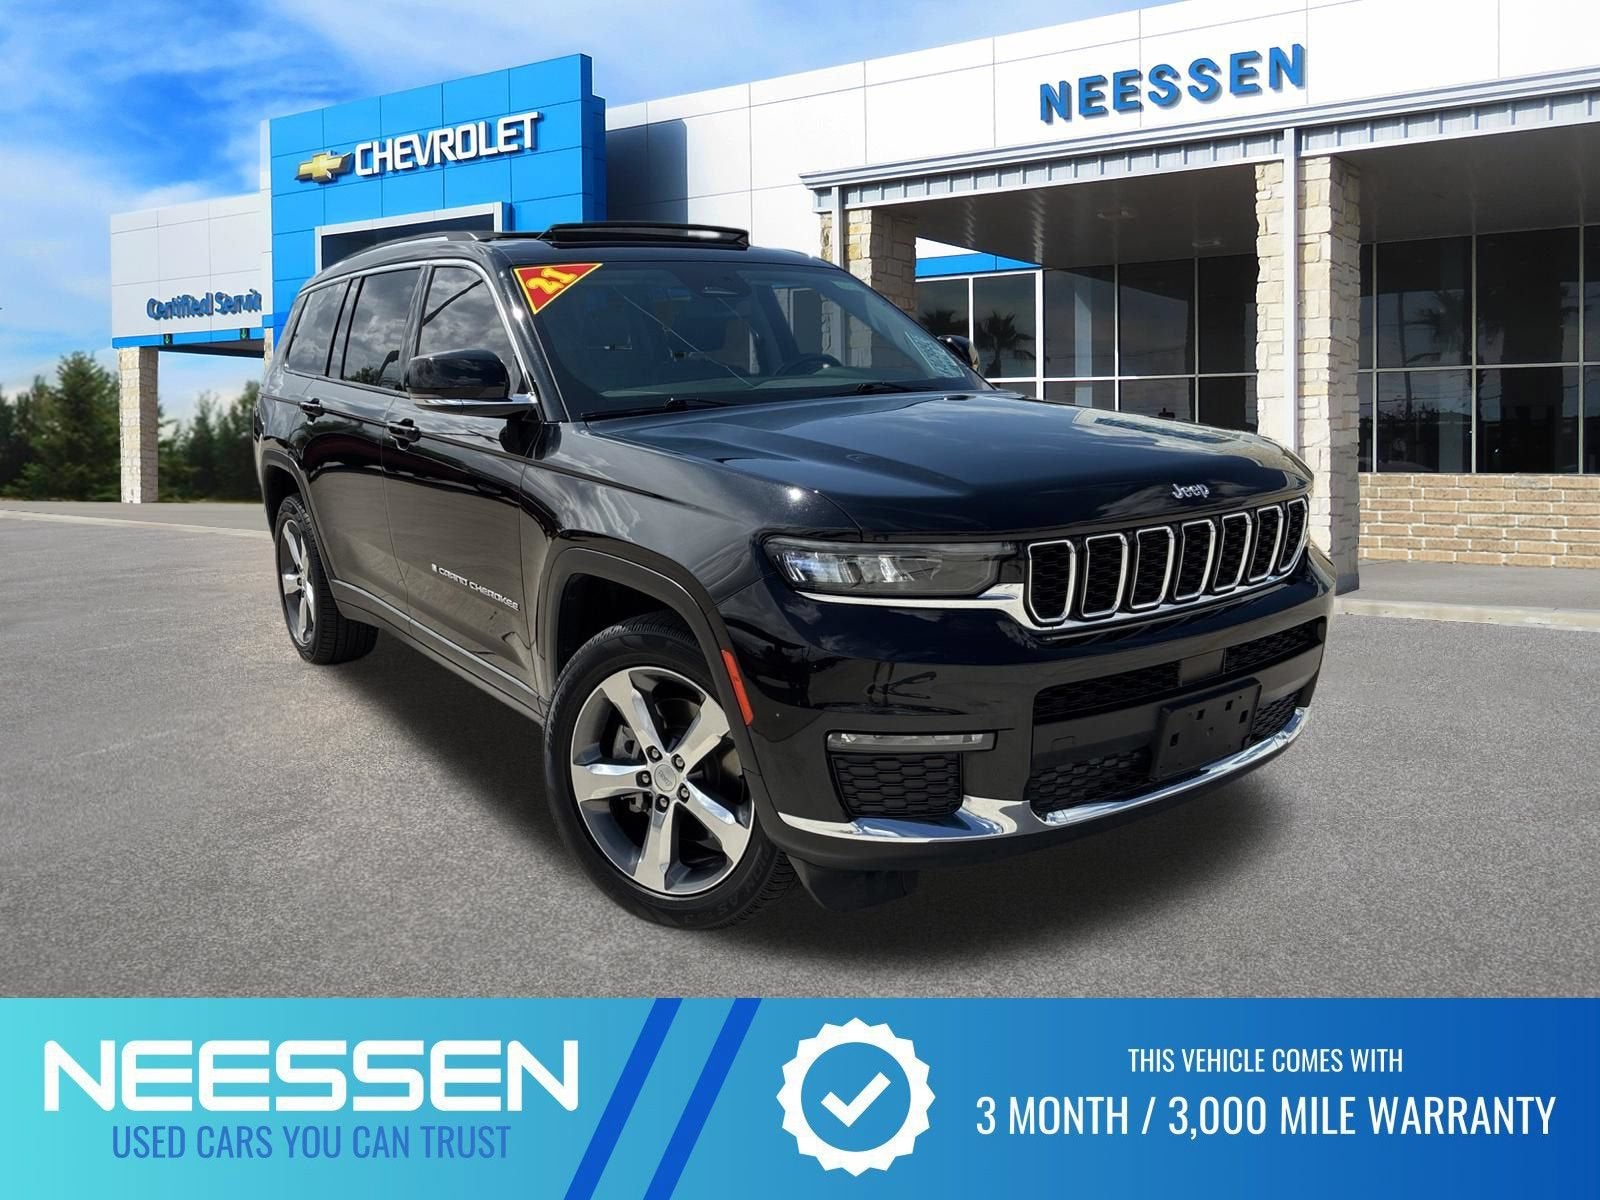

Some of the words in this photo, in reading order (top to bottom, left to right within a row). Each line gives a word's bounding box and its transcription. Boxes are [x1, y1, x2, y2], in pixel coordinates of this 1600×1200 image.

[1039, 43, 1305, 124] NEESSEN
[354, 111, 542, 177] CHEVROLET
[526, 267, 578, 295] 21
[146, 292, 214, 320] Certified
[1172, 483, 1210, 499] Jeep
[469, 581, 520, 611] CHEROKEE
